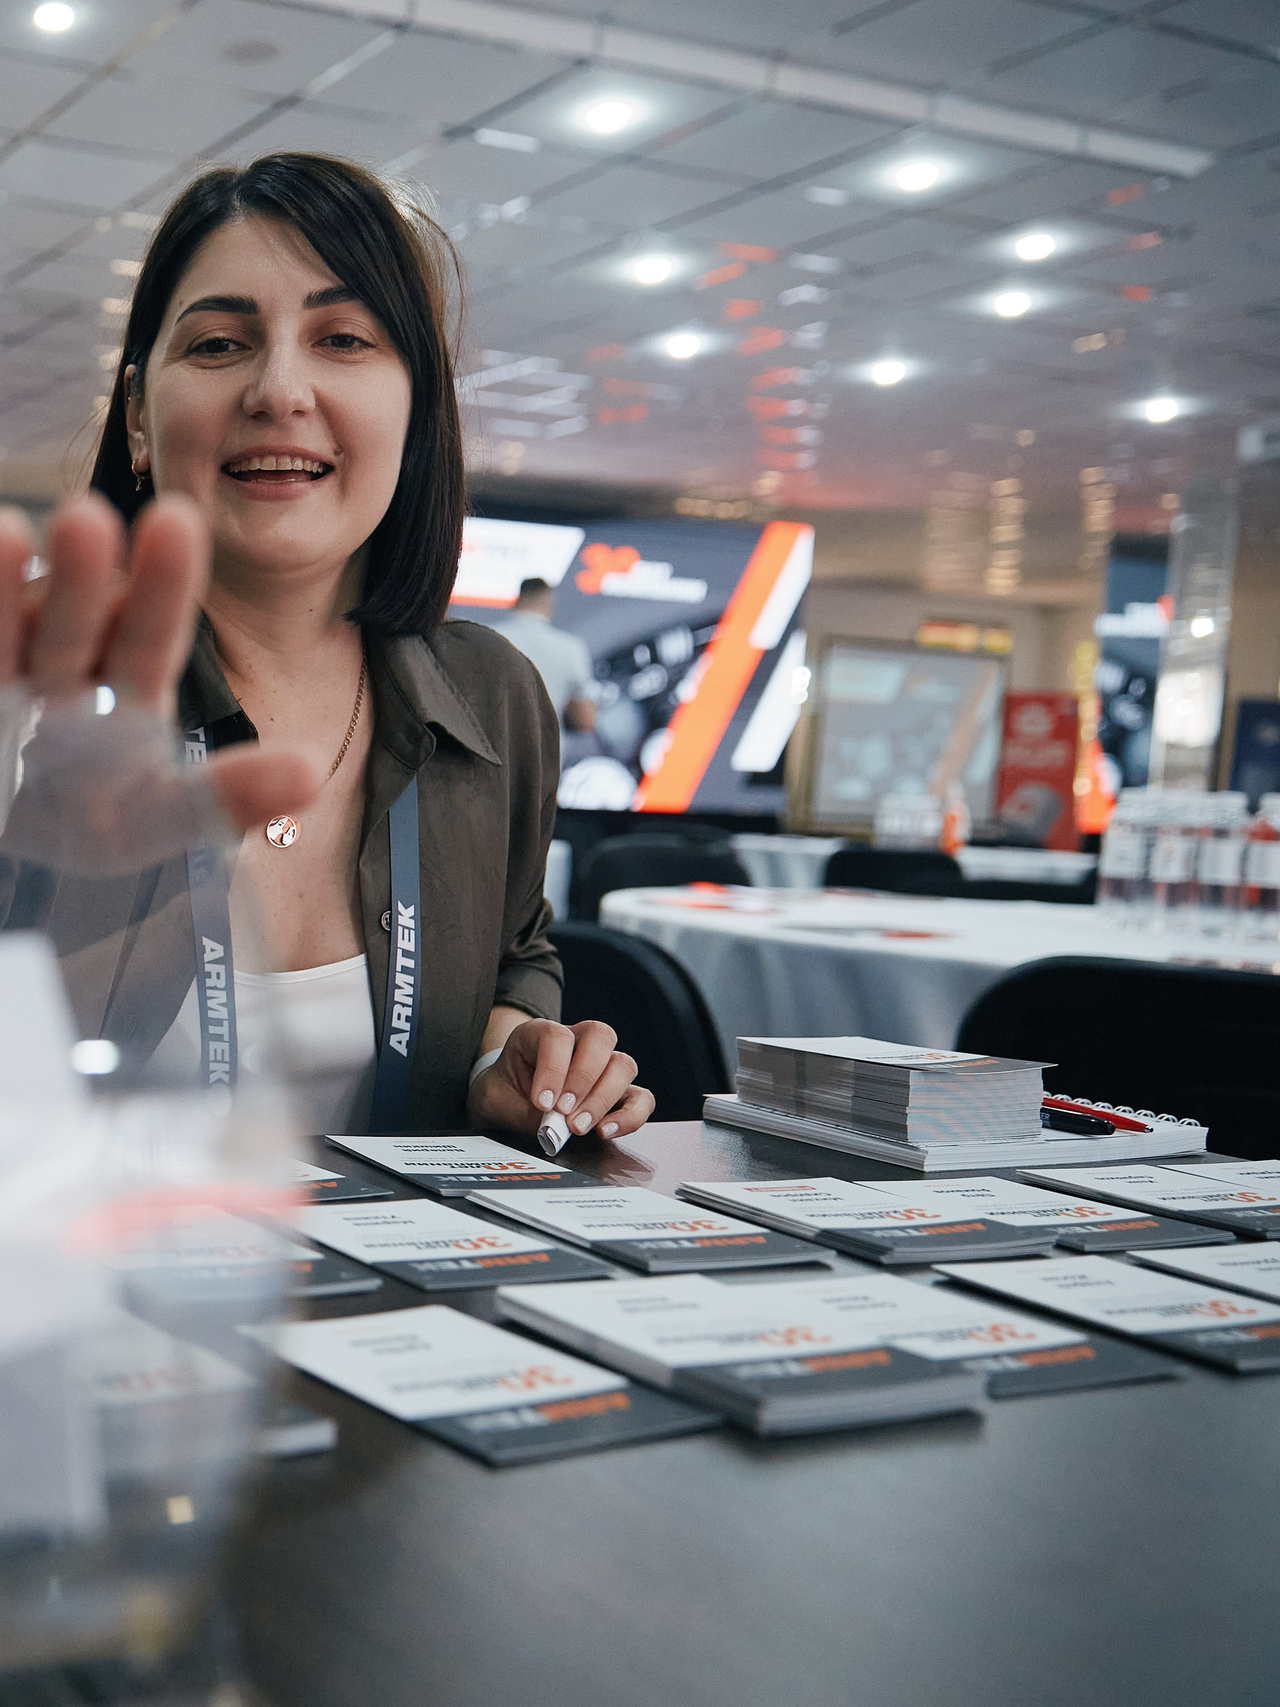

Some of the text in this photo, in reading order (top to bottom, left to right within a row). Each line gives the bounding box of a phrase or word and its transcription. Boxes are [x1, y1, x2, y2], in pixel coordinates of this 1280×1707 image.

[201, 935, 231, 1085] ARMTEK
[389, 900, 416, 1057] ARMTEK
[437, 1174, 562, 1182] ARMTEK
